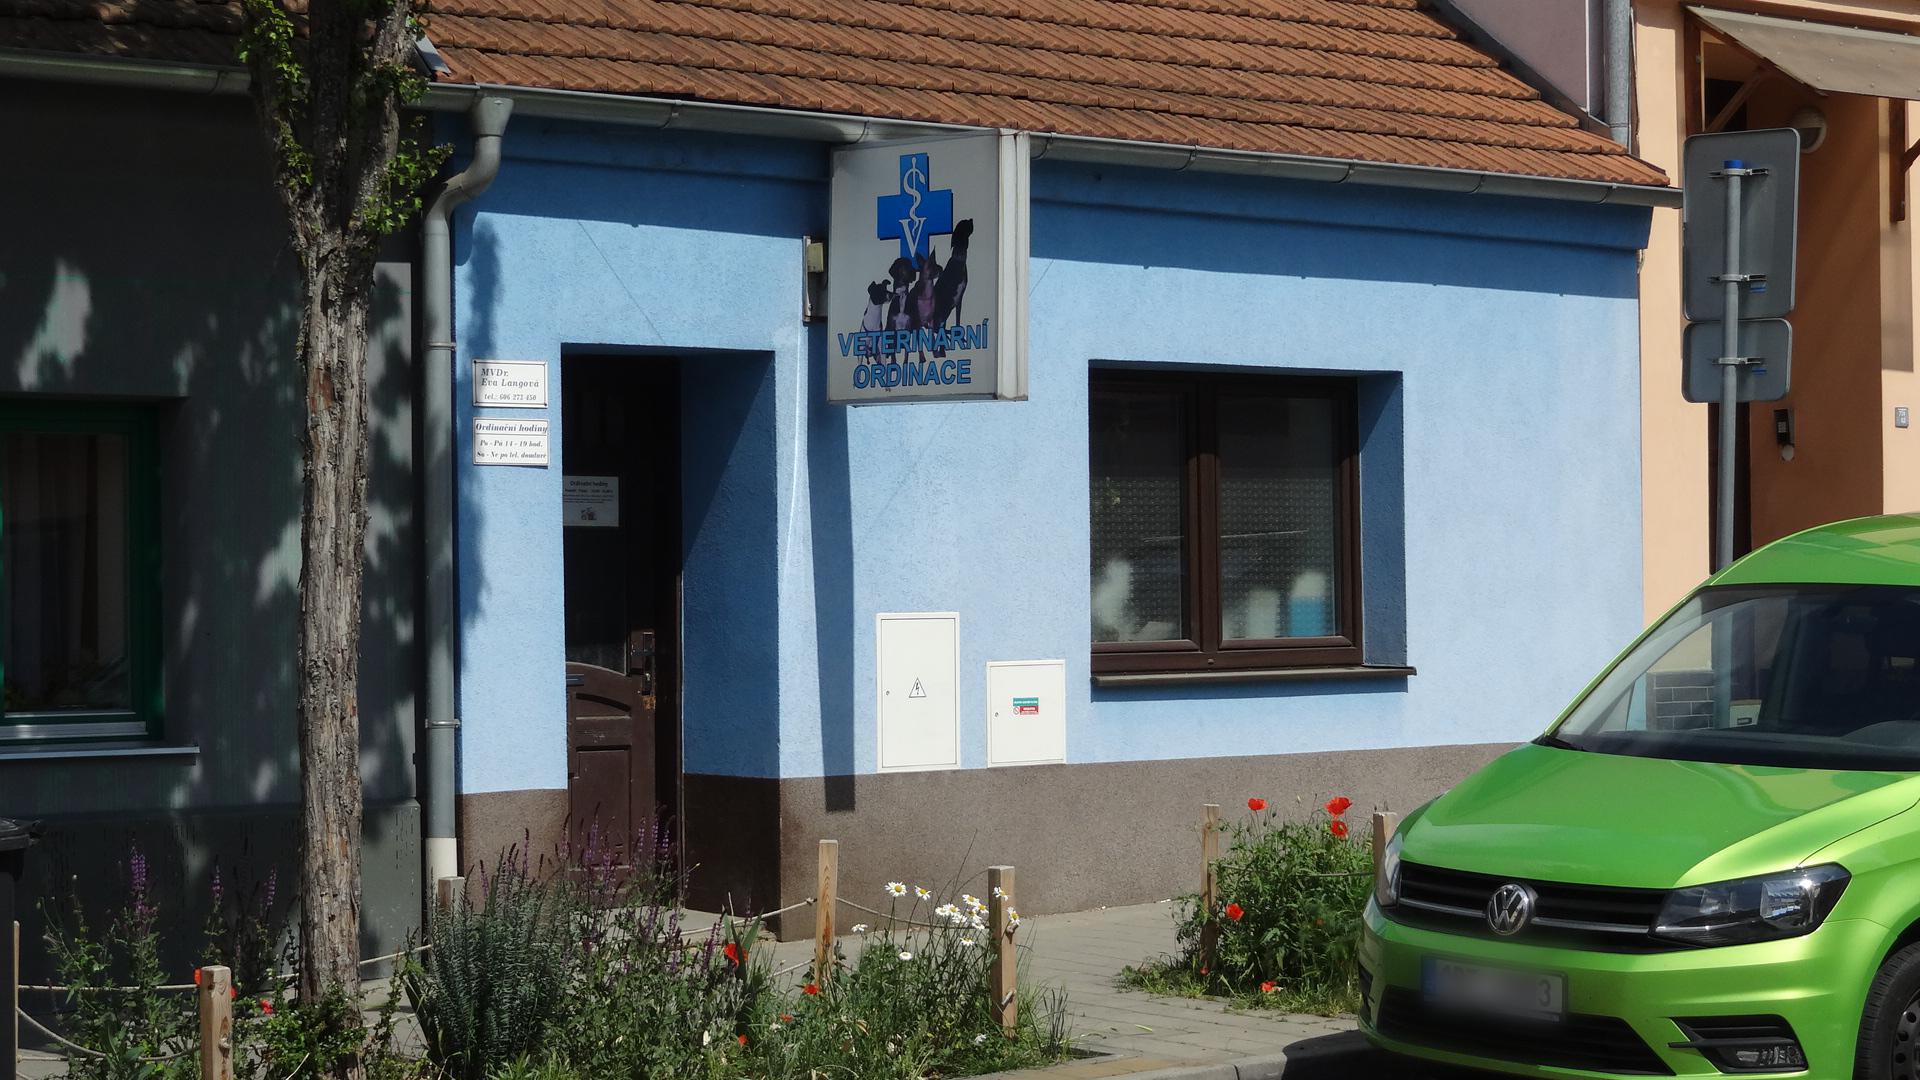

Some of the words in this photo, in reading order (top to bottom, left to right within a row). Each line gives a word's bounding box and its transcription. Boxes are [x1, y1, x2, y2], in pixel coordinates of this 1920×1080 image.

[838, 318, 989, 357] VETERINÁRNÍ
[481, 378, 498, 386] Eva
[501, 379, 539, 388] Langová
[853, 359, 972, 389] ORDINACE
[475, 423, 517, 432] Ordinační
[518, 424, 548, 433] hodiny
